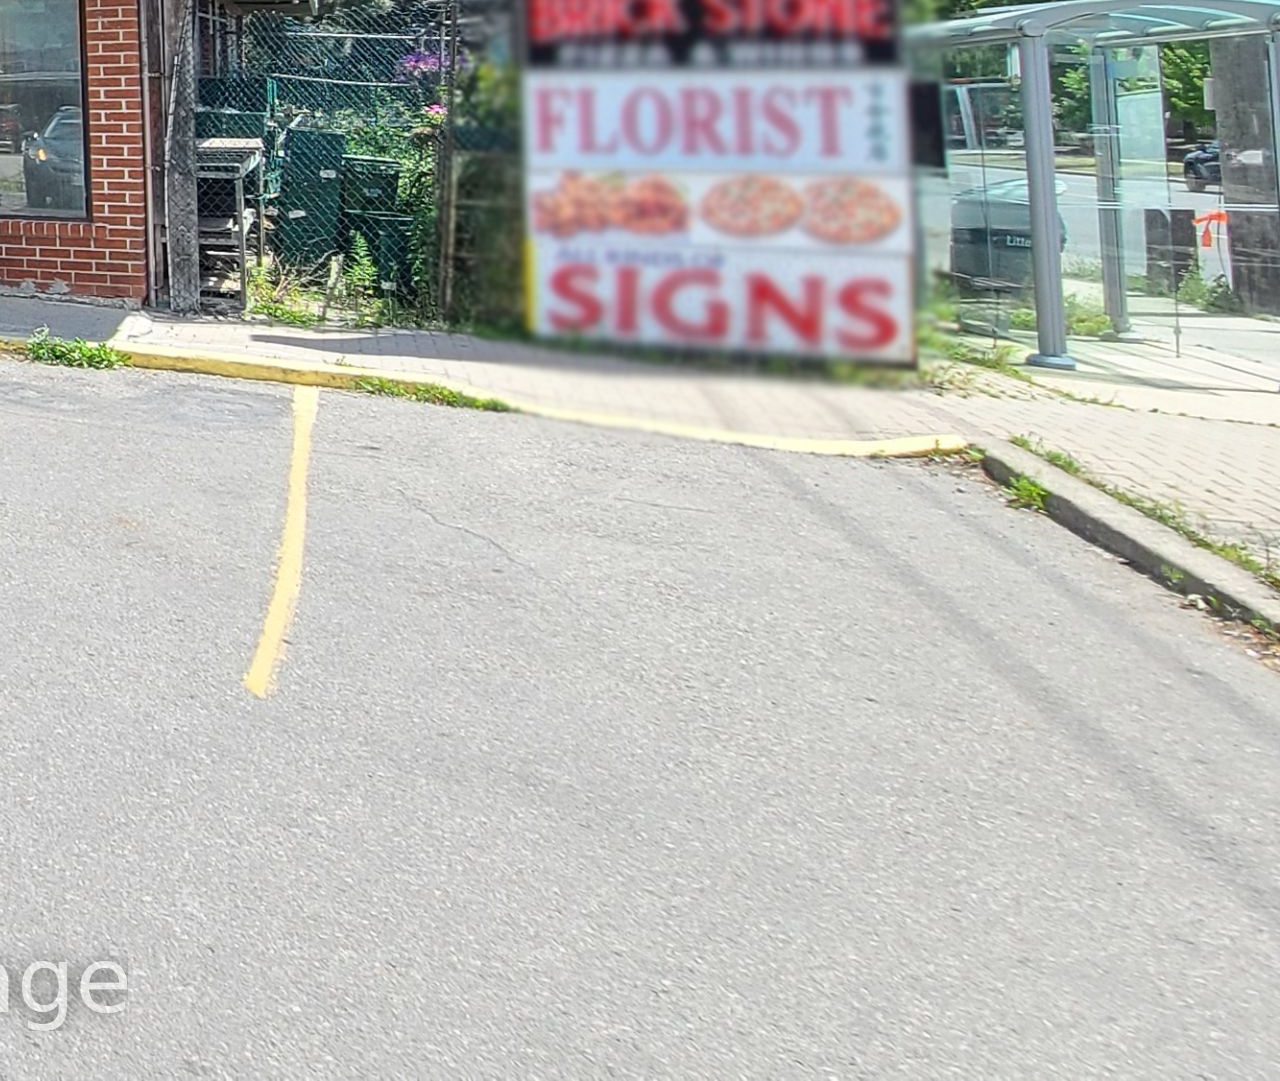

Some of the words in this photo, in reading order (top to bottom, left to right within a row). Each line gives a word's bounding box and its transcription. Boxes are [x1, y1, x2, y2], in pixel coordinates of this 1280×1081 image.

[534, 85, 852, 158] FLORIST
[1006, 235, 1031, 247] Litte
[547, 263, 899, 350] SIGNS
